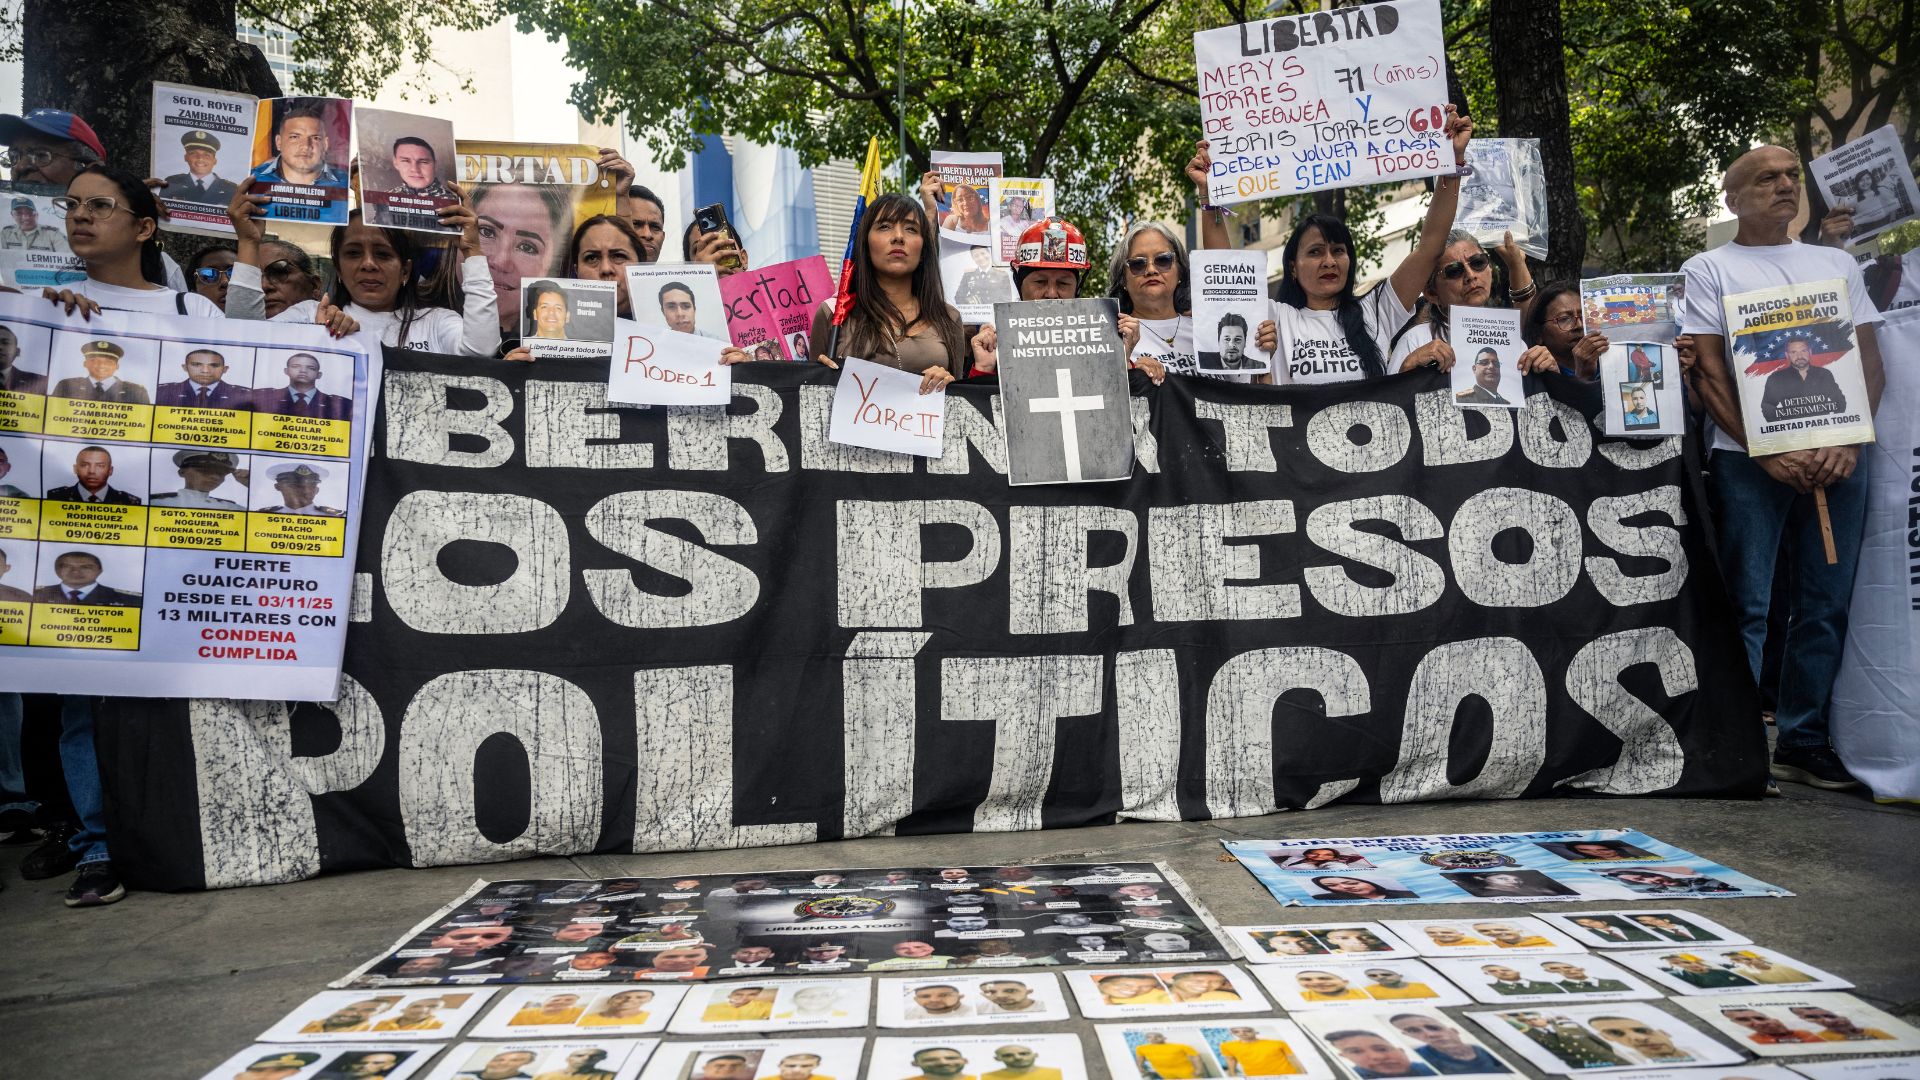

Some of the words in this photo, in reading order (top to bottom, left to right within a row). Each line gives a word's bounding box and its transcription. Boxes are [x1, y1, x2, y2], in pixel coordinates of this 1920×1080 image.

[1240, 5, 1399, 56] LIBERTAD
[1203, 56, 1304, 91] MERYS
[1334, 66, 1365, 93] 71
[1202, 82, 1297, 113] TORRES
[172, 95, 204, 108] SGTO.
[207, 100, 243, 114] ROYER
[1355, 95, 1372, 123] Y
[178, 108, 237, 125] ZAMBRANO
[1205, 115, 1235, 134] DE
[1303, 116, 1404, 143] TORRES
[1212, 156, 1281, 178] DEBEN
[1367, 138, 1379, 155] A
[1384, 138, 1441, 154] CASA
[455, 153, 610, 189] ERTAD!
[938, 166, 973, 176] LIBERTAD
[974, 168, 995, 177] PARA
[1295, 160, 1351, 190] SEAN
[965, 175, 989, 187] SÁNCH
[274, 205, 321, 220] LIBERTAD
[26, 253, 63, 264] LERMITH
[1203, 262, 1255, 274] GERMÁN
[1203, 275, 1256, 285] GIULIANI
[576, 300, 603, 309] Franklin
[1737, 298, 1791, 316] MARCOS
[1792, 291, 1839, 308] JAVIER
[1008, 316, 1064, 328] PRESOS
[1067, 314, 1086, 326] DE
[1090, 313, 1109, 324] LA
[1744, 312, 1794, 329] AGÜERO
[1796, 305, 1839, 321] BRAVO
[1017, 327, 1103, 346] MUERTE
[1468, 329, 1508, 338] JHOLMAR
[1466, 336, 1511, 346] CARDENAS
[529, 343, 558, 351] Libertad
[559, 345, 575, 353] para
[575, 345, 596, 354] todos
[596, 346, 608, 355] los
[1012, 344, 1115, 358] INSTITUCIONAL
[1292, 347, 1317, 361] LOS
[1289, 358, 1360, 378] POLÍTIC
[68, 400, 99, 409] SGTO.
[100, 403, 134, 412] ROYER
[1783, 394, 1826, 407] DETENIDO
[72, 409, 128, 420] ZAMBRANO
[170, 408, 197, 416] PTTE.
[198, 411, 236, 419] WILLIAN
[1775, 401, 1839, 418] INJUSTAMENTE
[52, 415, 97, 425] CONDENA
[181, 417, 224, 426] PAREDES
[272, 415, 295, 424] CAP.
[296, 418, 332, 427] CARLOS
[1760, 421, 1804, 435] LIBERTAD
[1804, 417, 1830, 429] PARA
[1830, 413, 1861, 425] TODOS
[71, 425, 126, 438] 23/02/25
[157, 423, 199, 432] CONDENA
[281, 424, 322, 434] AGUILAR
[174, 432, 229, 445] 30/03/25
[257, 430, 299, 440] CONDENA
[274, 440, 327, 453] 26/03/25
[61, 503, 84, 512] CAP.
[86, 504, 128, 514] NICOLAS
[160, 510, 189, 518] SGTO.
[190, 511, 235, 520] YOHNSER
[66, 512, 123, 522] RODRIGUEZ
[174, 519, 220, 528] NOGUERA
[266, 516, 295, 525] SGTO.
[296, 518, 328, 526] EDGAR
[48, 520, 92, 529] CONDENA
[94, 523, 139, 531] CUMPLIDA
[153, 526, 195, 535] CONDENA
[195, 529, 240, 537] CUMPLIDA
[281, 525, 313, 534] BACHO
[65, 529, 121, 541] 09/06/25
[168, 535, 223, 547] 09/09/25
[254, 531, 295, 540] CONDENA
[296, 534, 338, 543] CUMPLIDA
[270, 540, 322, 552] 09/09/25
[214, 557, 291, 573] FUERTE
[348, 486, 760, 636] OS
[836, 485, 1689, 635] PRESOS
[182, 574, 319, 592] GUAICAIPURO
[164, 591, 225, 606] DESDE
[231, 594, 253, 606] EL
[258, 595, 333, 609] 03/11/25
[50, 607, 85, 615] TCNEL.
[87, 609, 124, 617] VICTOR
[157, 609, 181, 622] 13
[187, 610, 292, 626] MILITARES
[298, 615, 337, 627] CON
[40, 623, 85, 632] CONDENA
[87, 626, 133, 634] CUMPLIDA
[56, 633, 113, 644] 09/09/25
[201, 628, 297, 644] CONDENA
[197, 646, 298, 661] CUMPLIDA
[190, 625, 1700, 888] POLÍTICOS
